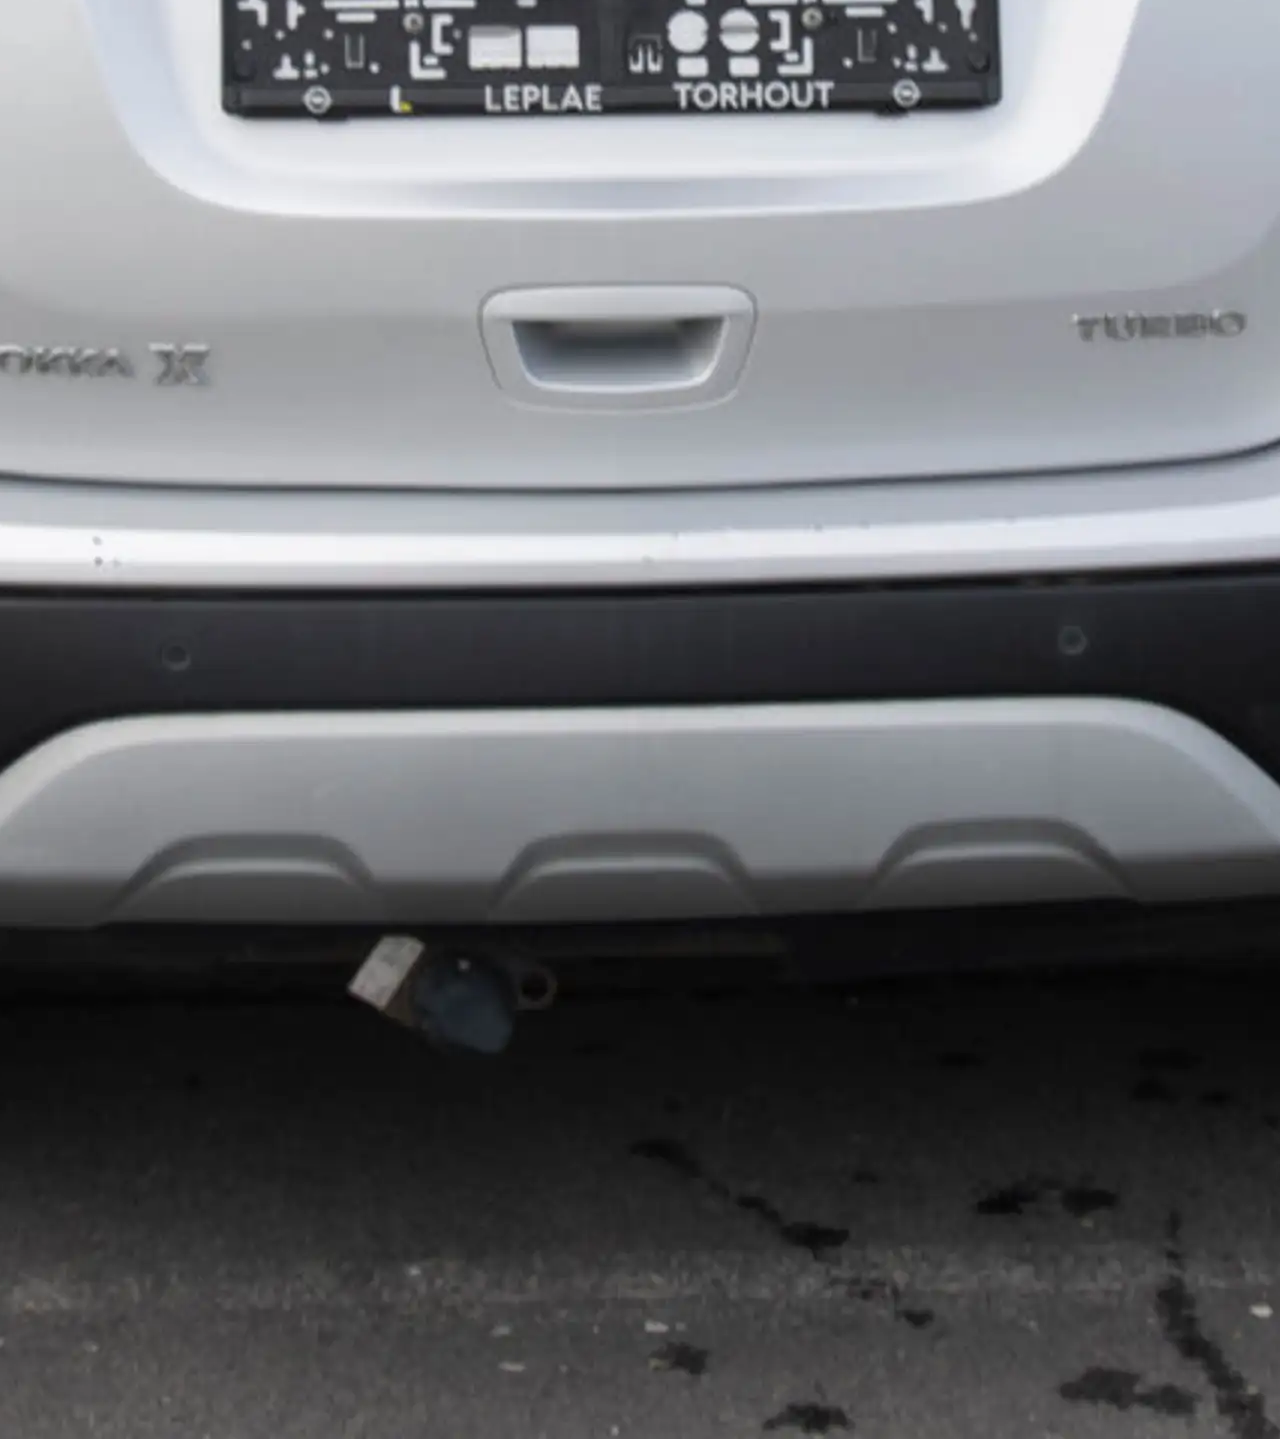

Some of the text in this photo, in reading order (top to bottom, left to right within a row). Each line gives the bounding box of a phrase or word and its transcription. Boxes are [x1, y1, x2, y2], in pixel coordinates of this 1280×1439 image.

[484, 81, 835, 111] LEPLAE TORHOUT
[1072, 309, 1248, 343] TURBO
